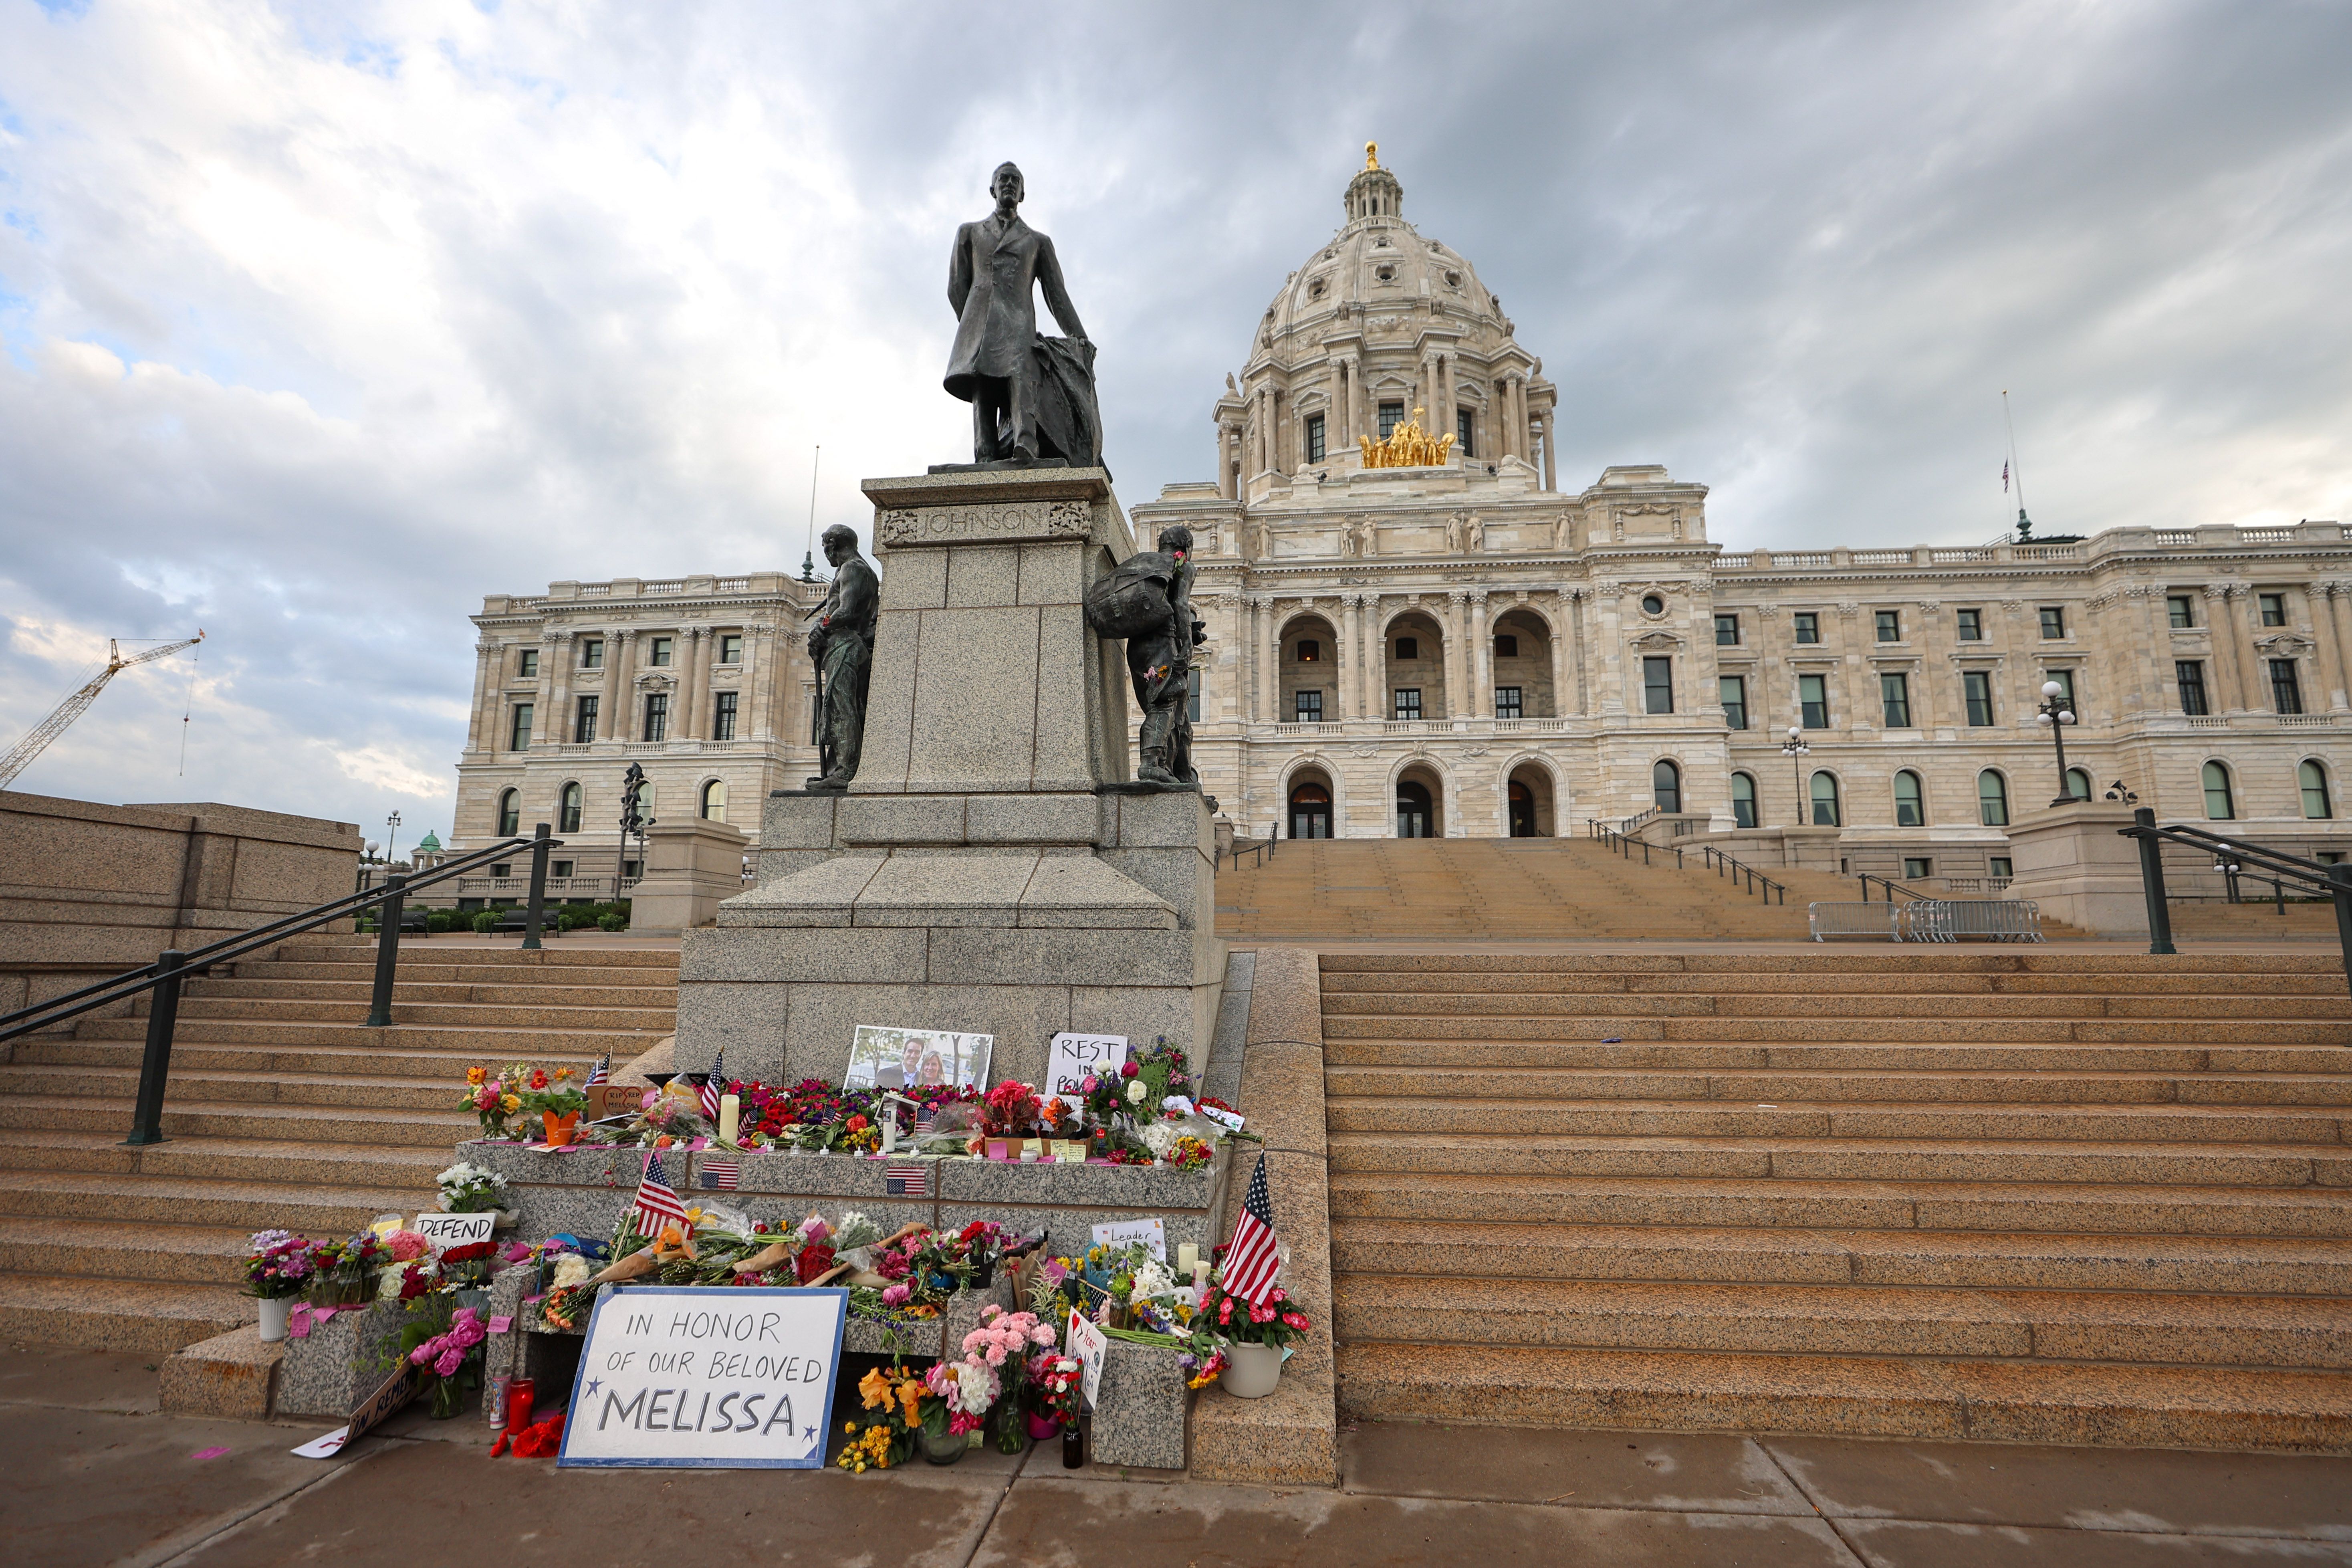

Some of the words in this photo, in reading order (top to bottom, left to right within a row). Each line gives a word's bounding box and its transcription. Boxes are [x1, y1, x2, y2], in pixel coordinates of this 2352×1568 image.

[920, 509, 1042, 537] JOHNSON
[1061, 1039, 1120, 1062] REST
[1078, 1064, 1093, 1075] IN
[418, 1219, 491, 1239] DEFEND
[1111, 1228, 1151, 1241] Leader
[626, 1314, 654, 1336] IN
[669, 1312, 781, 1344] HONOR
[1082, 1328, 1097, 1350] fear
[607, 1351, 636, 1371] OF
[648, 1351, 695, 1376] OUR
[708, 1351, 822, 1383] BELOVED
[597, 1387, 795, 1437] MELISSA
